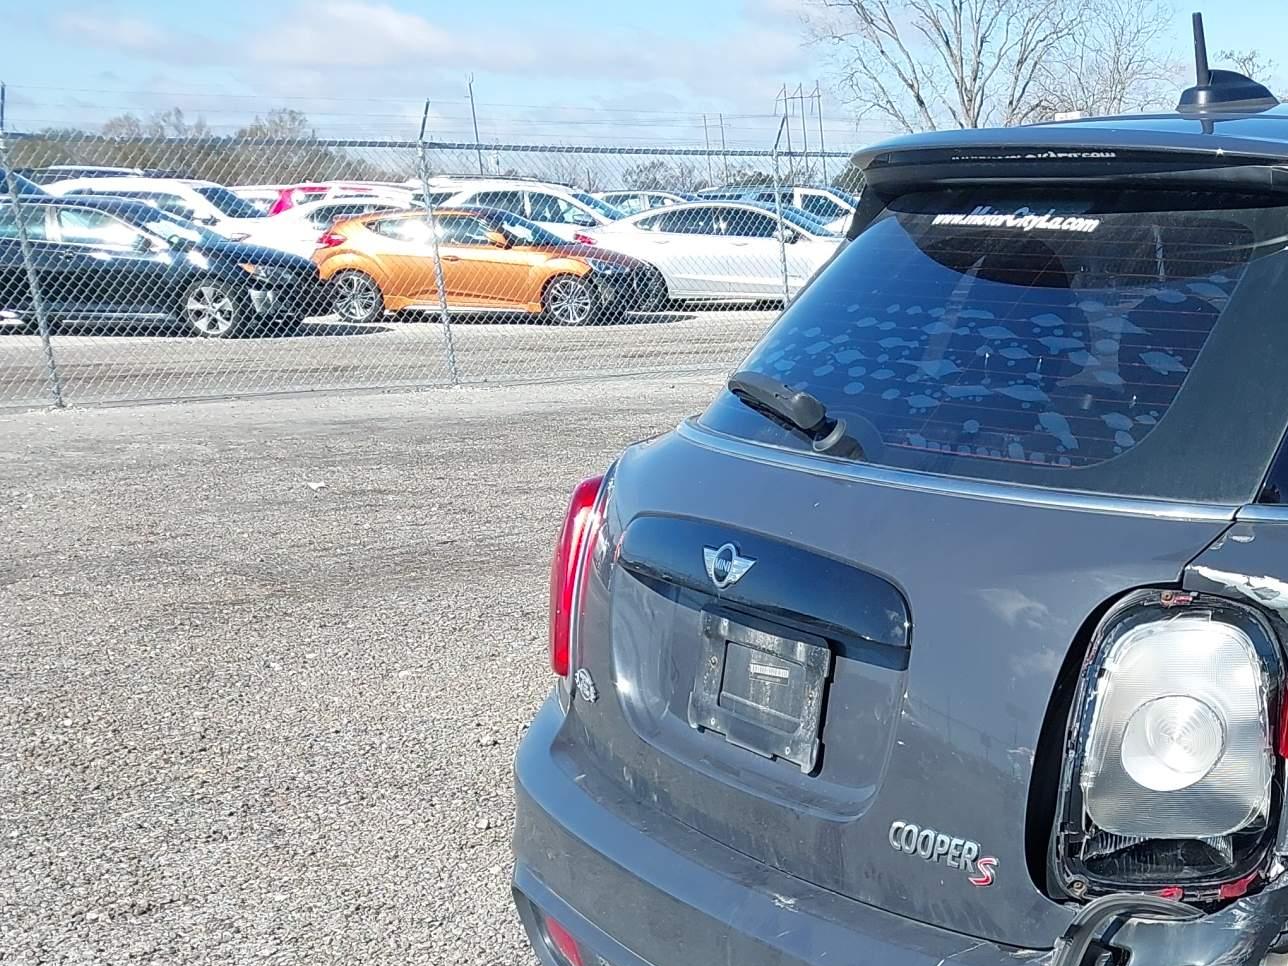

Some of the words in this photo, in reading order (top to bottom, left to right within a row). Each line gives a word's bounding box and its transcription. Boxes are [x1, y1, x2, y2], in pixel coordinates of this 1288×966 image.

[715, 557, 732, 573] MINI
[888, 821, 980, 873] COOPER
[967, 857, 999, 886] S
